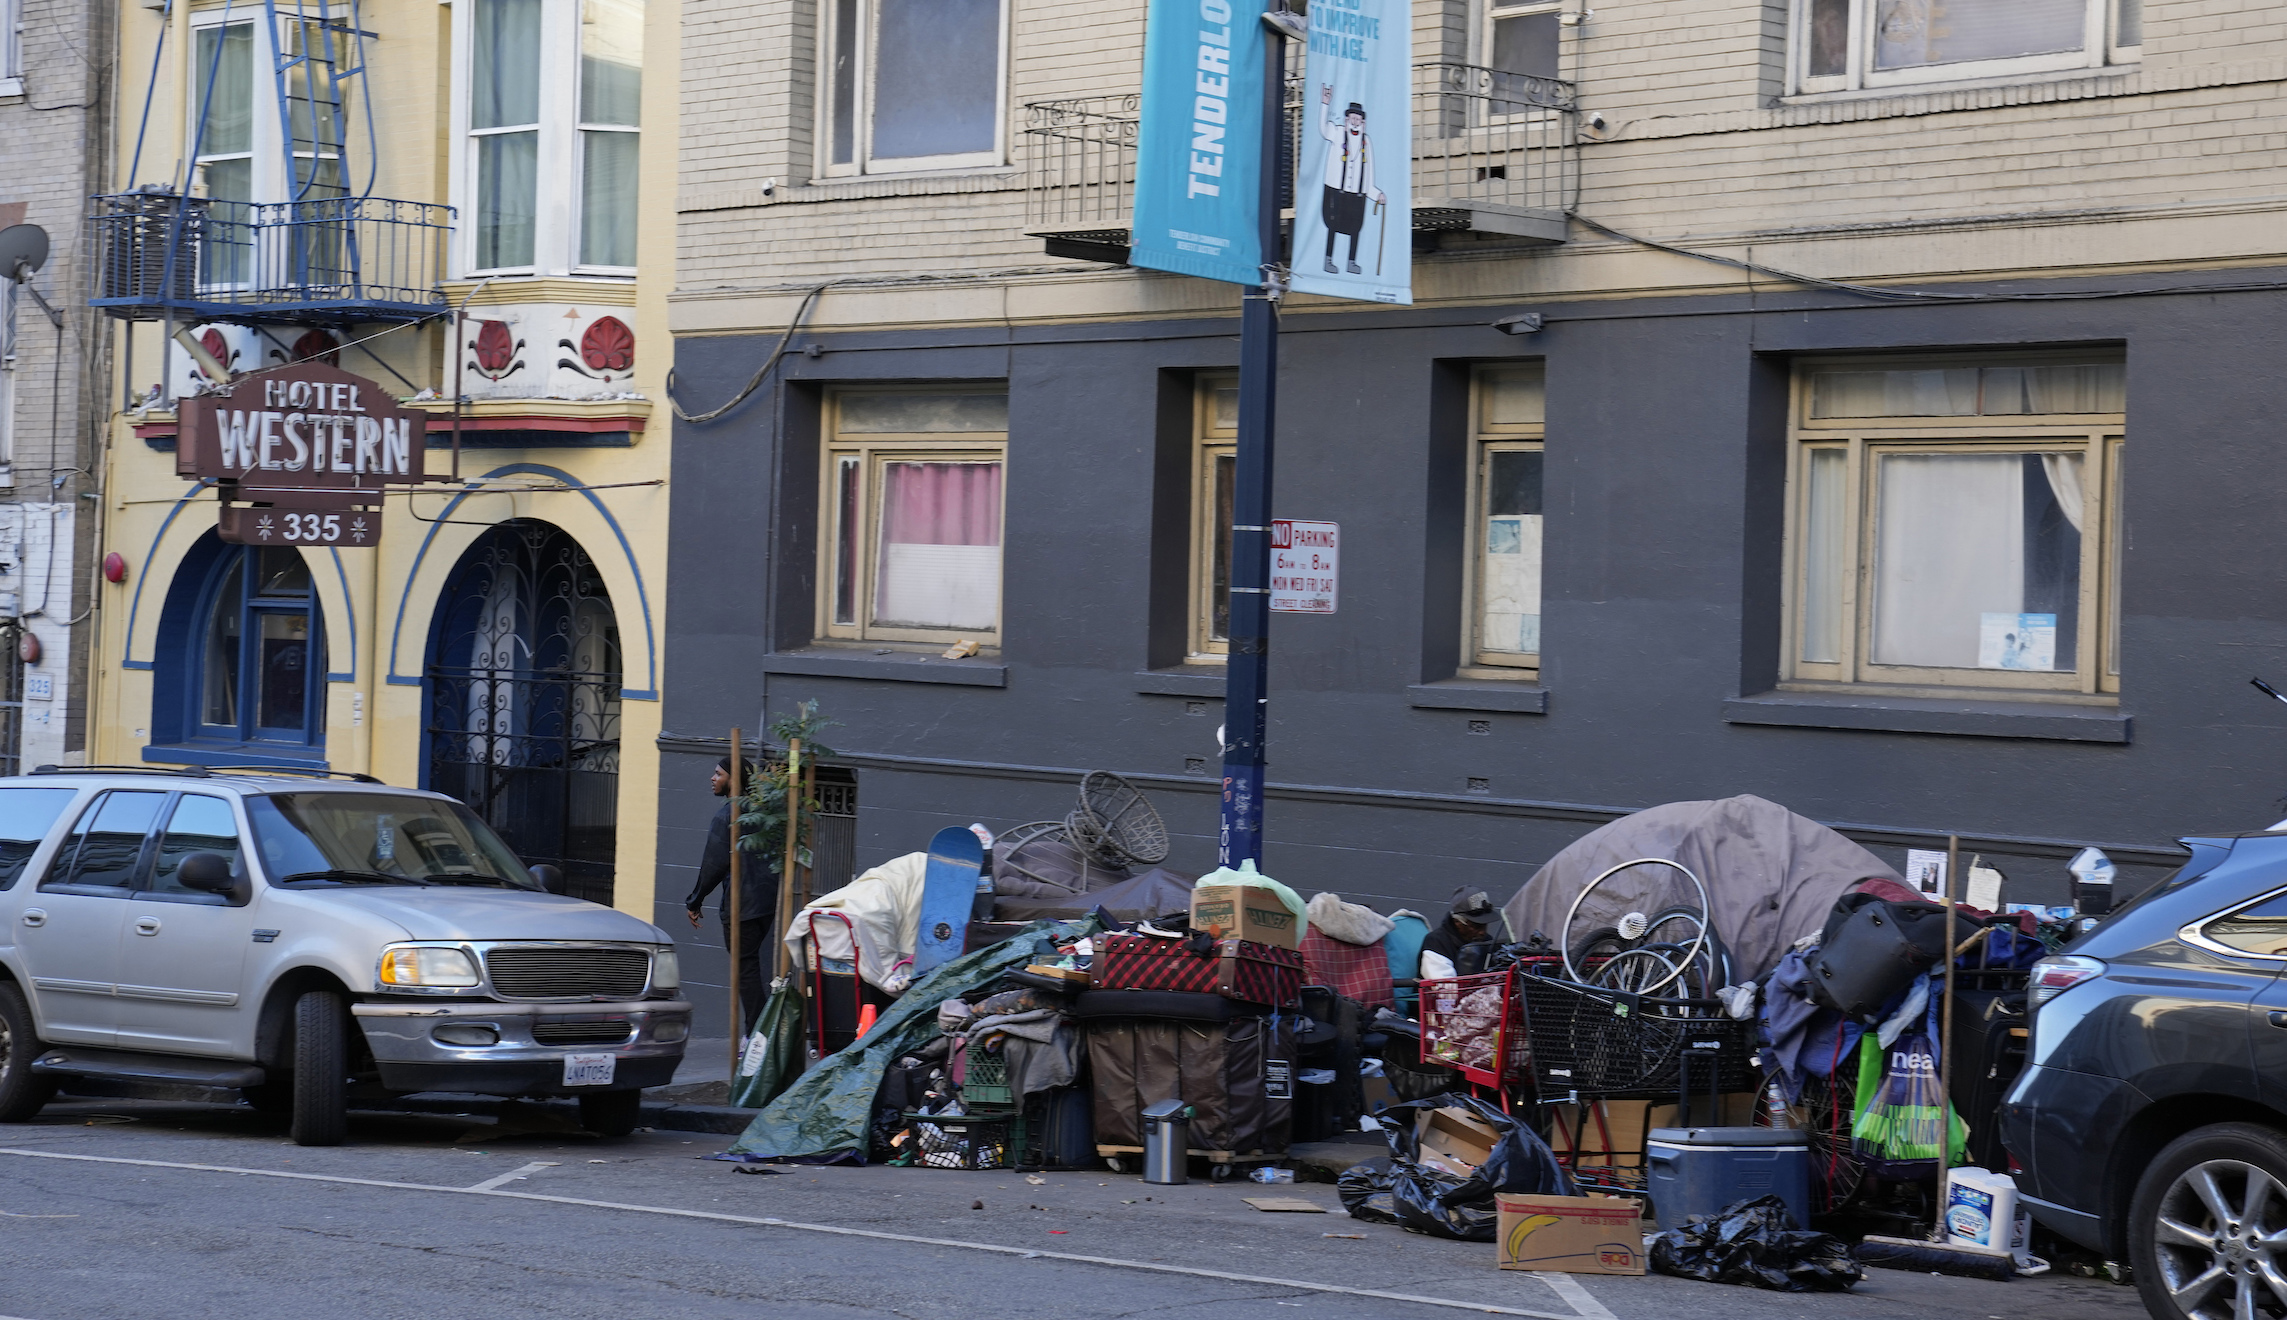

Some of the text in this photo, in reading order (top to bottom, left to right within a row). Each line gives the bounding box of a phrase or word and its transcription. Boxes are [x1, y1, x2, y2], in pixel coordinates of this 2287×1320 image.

[1310, 4, 1380, 40] TO IMPROVE
[1308, 28, 1368, 62] WITH AGE.
[265, 379, 366, 412] HOTEL
[216, 409, 410, 475] WESTERN
[282, 513, 341, 541] 335
[1272, 523, 1335, 548] NO PARKING
[1272, 576, 1333, 592] MON WED FRI SAT
[1274, 598, 1297, 608] STREET
[30, 679, 50, 694] 325
[1602, 1217, 1630, 1226] SINGLE
[1600, 1254, 1630, 1266] Dole
